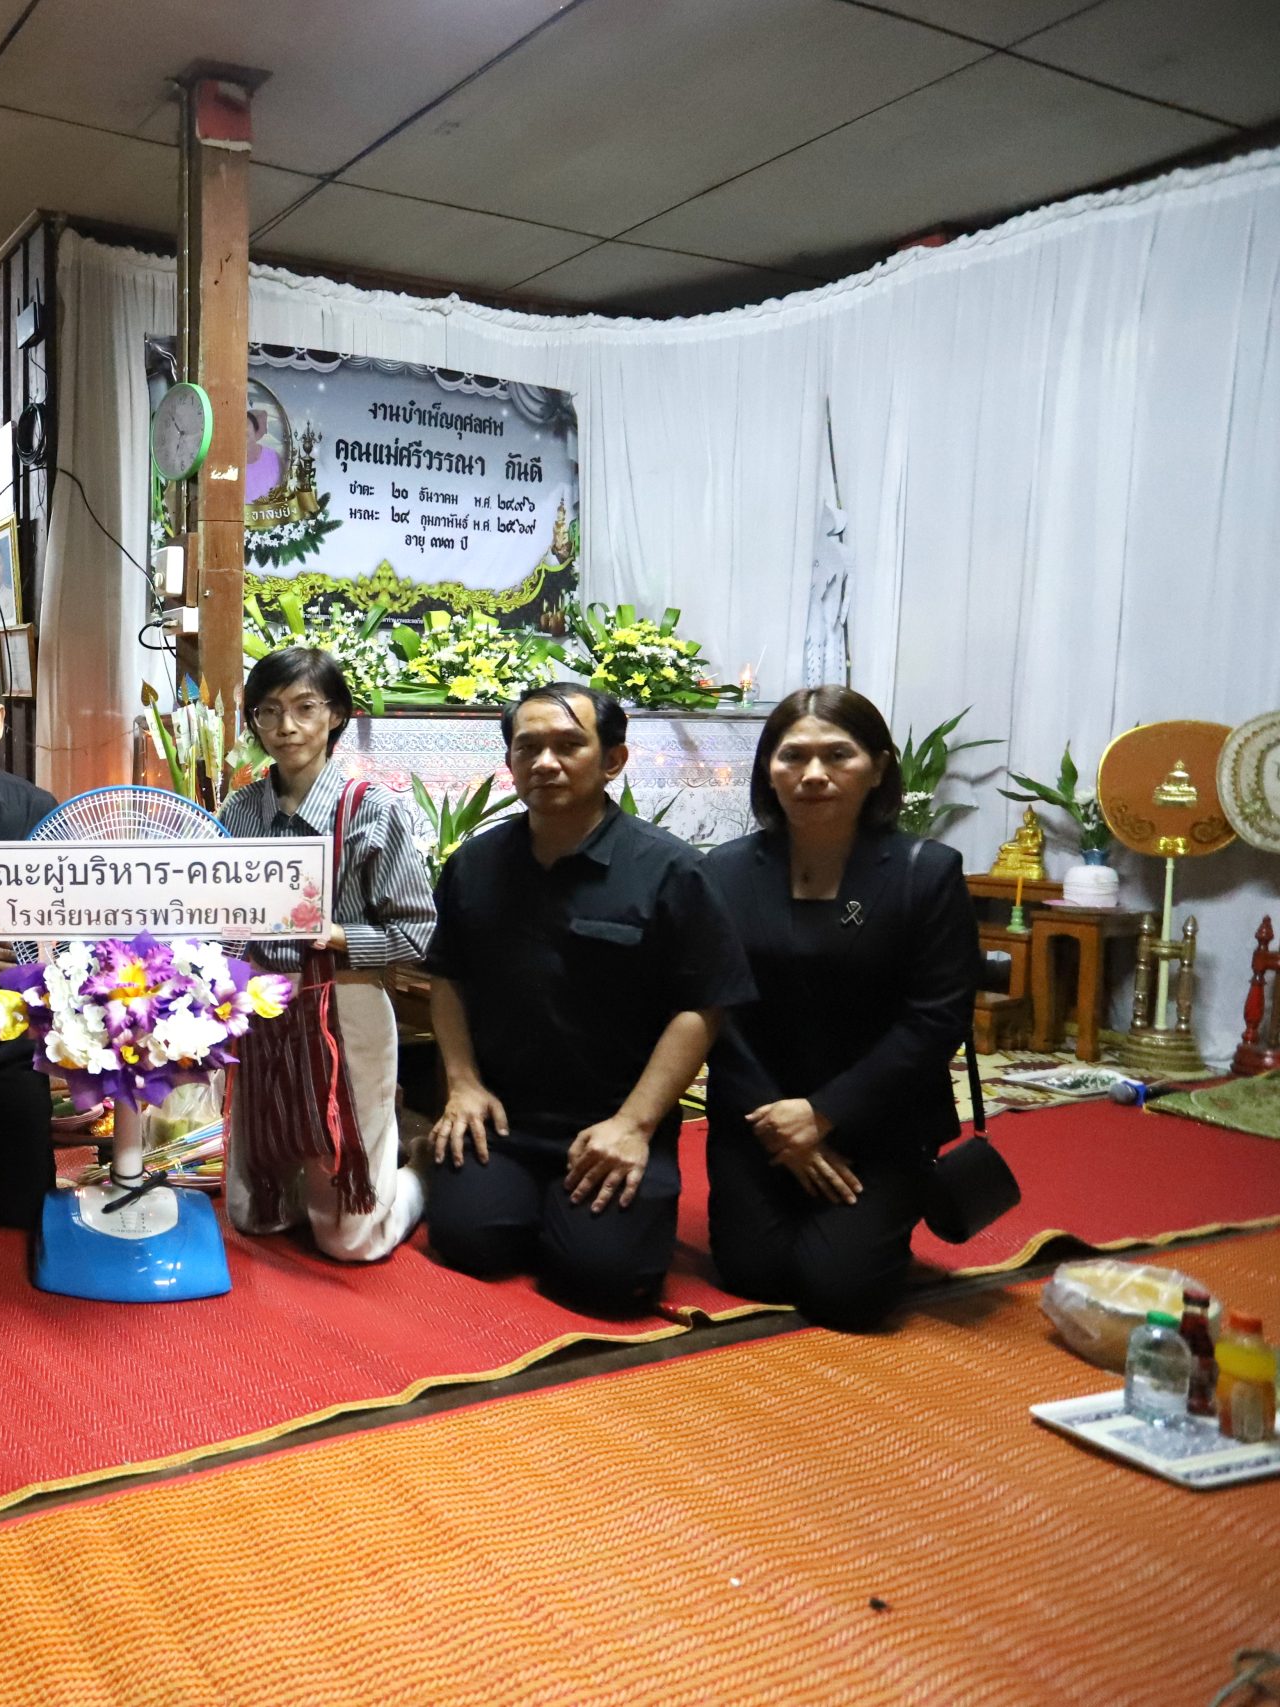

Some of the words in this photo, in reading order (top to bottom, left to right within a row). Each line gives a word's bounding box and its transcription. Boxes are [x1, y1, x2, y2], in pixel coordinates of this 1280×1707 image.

[368, 400, 504, 440] งานบำเพ็ญกุศลศพ
[335, 437, 485, 477] คุณแม่ศรีวรรณา
[391, 481, 409, 500] ๒๐
[418, 486, 458, 505] ธันวาคม
[474, 495, 492, 510] พ.ศ.
[497, 493, 536, 513] ๒๔๙๖
[349, 507, 380, 521] มรณะ
[391, 505, 410, 524] ๒๔
[420, 513, 470, 532] กุมภาพันธ์
[473, 519, 492, 533] พ.ศ.
[497, 516, 537, 535] ๒๕๖๙
[404, 534, 426, 554] อายุ
[460, 535, 469, 551] ปี
[6, 898, 267, 928] โรงเรียนสรรพวิทยาคม
